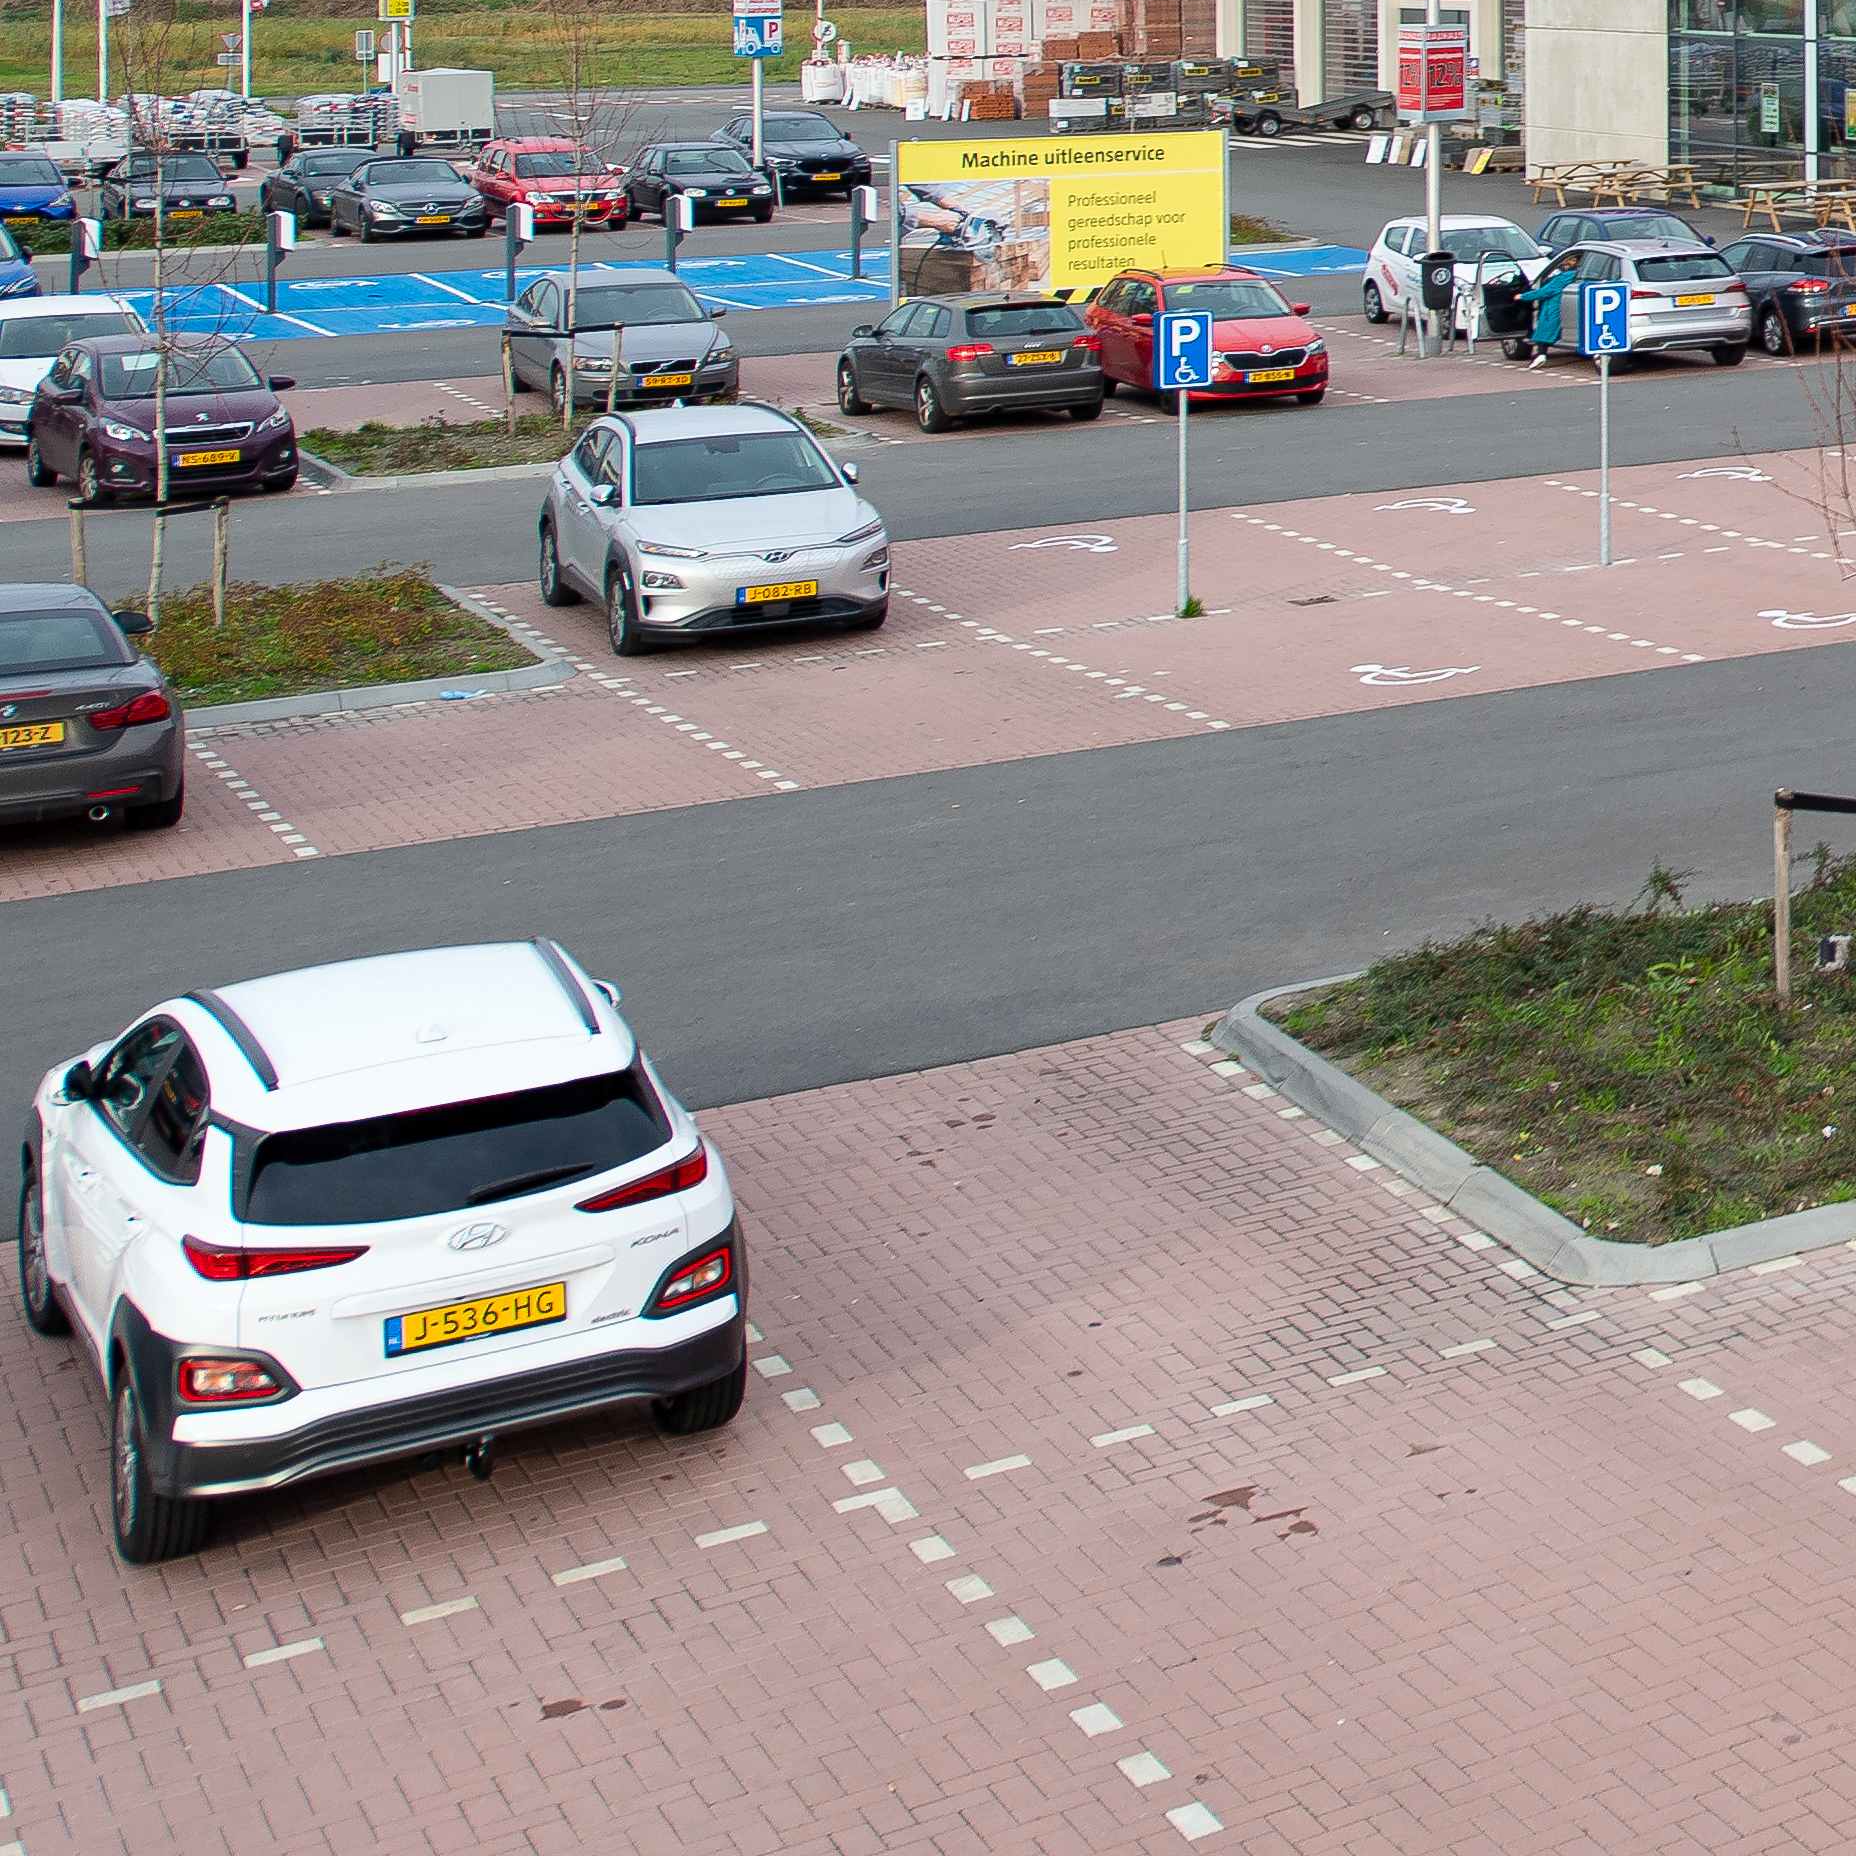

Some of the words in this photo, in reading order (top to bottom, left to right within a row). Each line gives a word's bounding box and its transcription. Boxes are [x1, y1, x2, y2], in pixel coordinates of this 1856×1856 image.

[768, 21, 779, 39] P
[961, 149, 1039, 168] Machine
[1044, 146, 1165, 164] uitleenservice
[1068, 191, 1157, 207] Professioneel
[1068, 213, 1153, 231] gereedschap
[1156, 212, 1187, 224] voor
[1068, 233, 1157, 253] professionele
[1068, 254, 1136, 271] resultaten
[1595, 289, 1621, 325] P
[1171, 318, 1201, 357] P
[629, 1227, 680, 1248] KONA
[414, 1290, 555, 1342] J-536-HG
